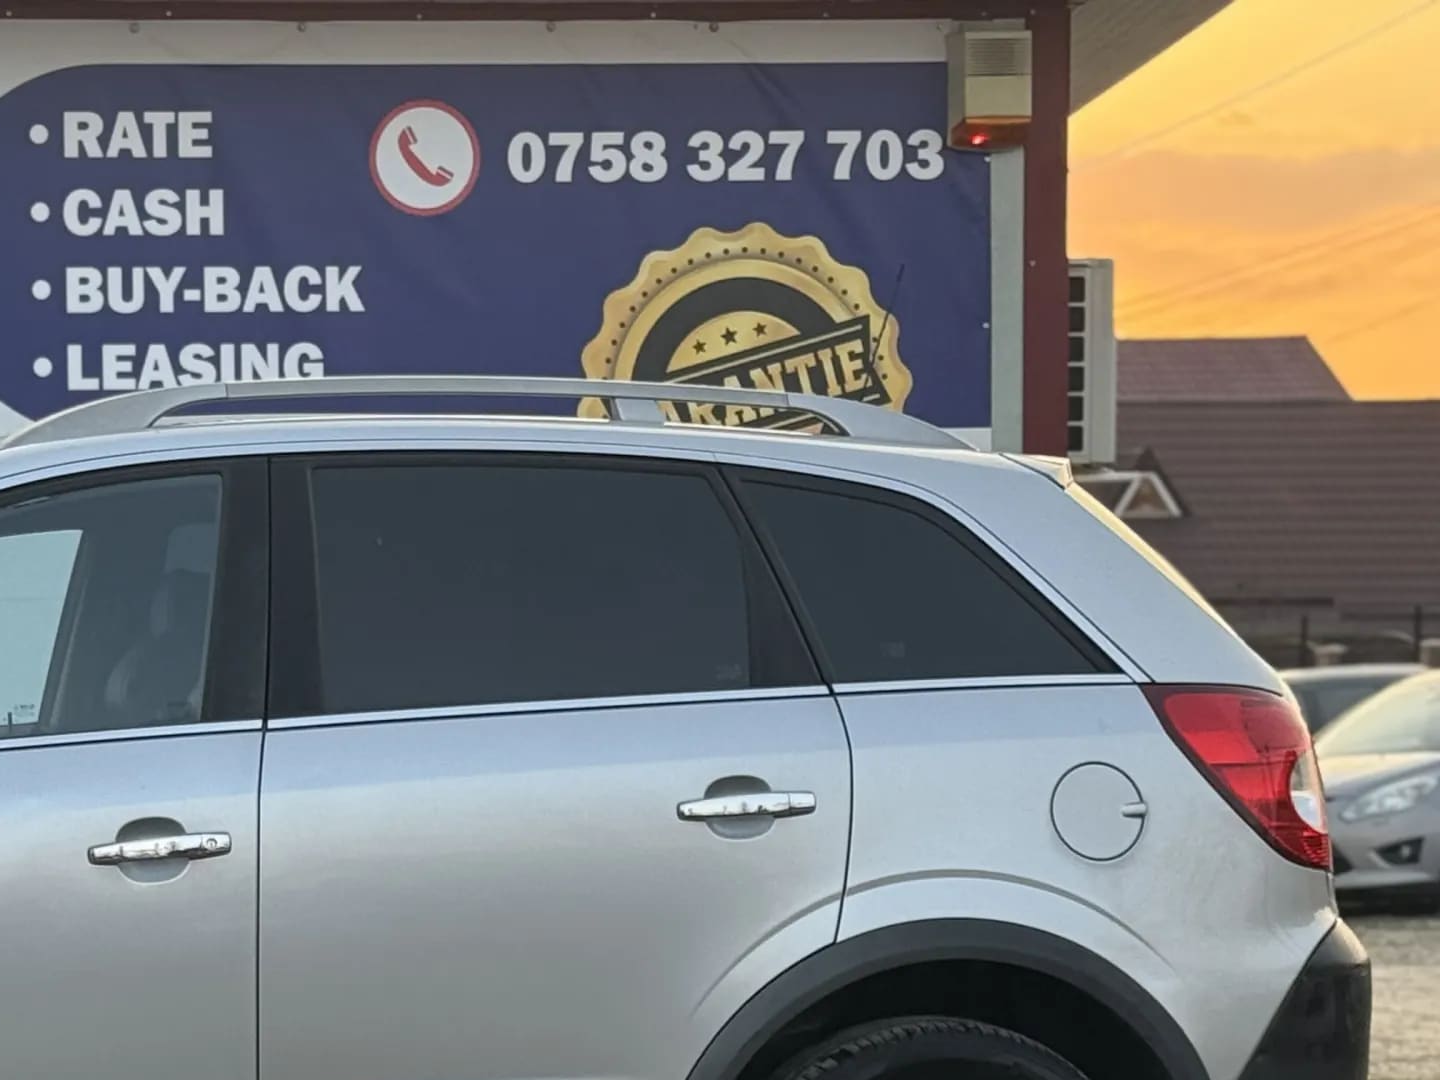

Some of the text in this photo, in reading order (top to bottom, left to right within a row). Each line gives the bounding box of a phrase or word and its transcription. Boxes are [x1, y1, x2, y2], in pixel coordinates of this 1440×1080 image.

[63, 111, 213, 158] RATE
[506, 129, 945, 183] 0758 327 703
[62, 188, 225, 237] CASH
[65, 265, 366, 314] BUY-BACK
[66, 342, 325, 391] LEASING
